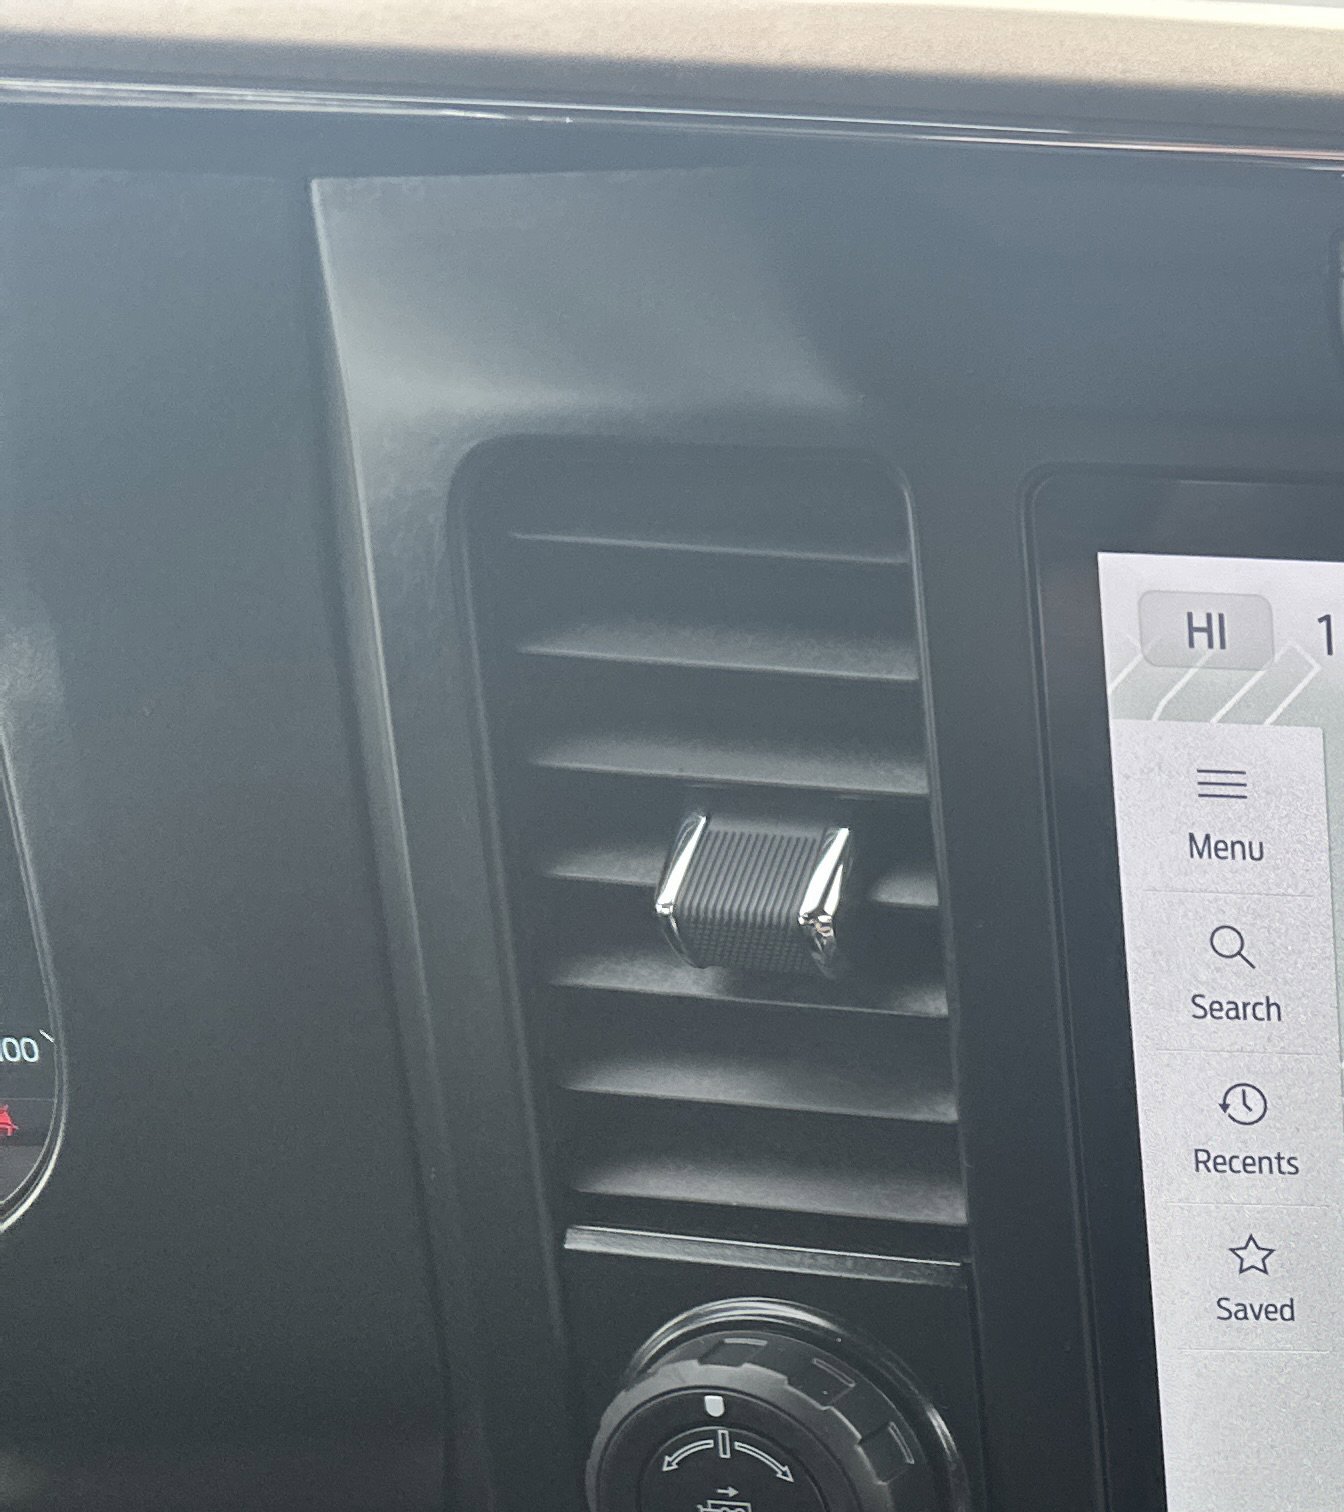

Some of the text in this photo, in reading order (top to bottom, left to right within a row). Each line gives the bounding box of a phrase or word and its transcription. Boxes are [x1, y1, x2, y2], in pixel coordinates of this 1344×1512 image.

[1186, 611, 1227, 650] HI
[1188, 832, 1264, 862] Menu
[1191, 993, 1282, 1022] Search
[1194, 1148, 1300, 1176] Recents
[1216, 1297, 1296, 1322] Saved
